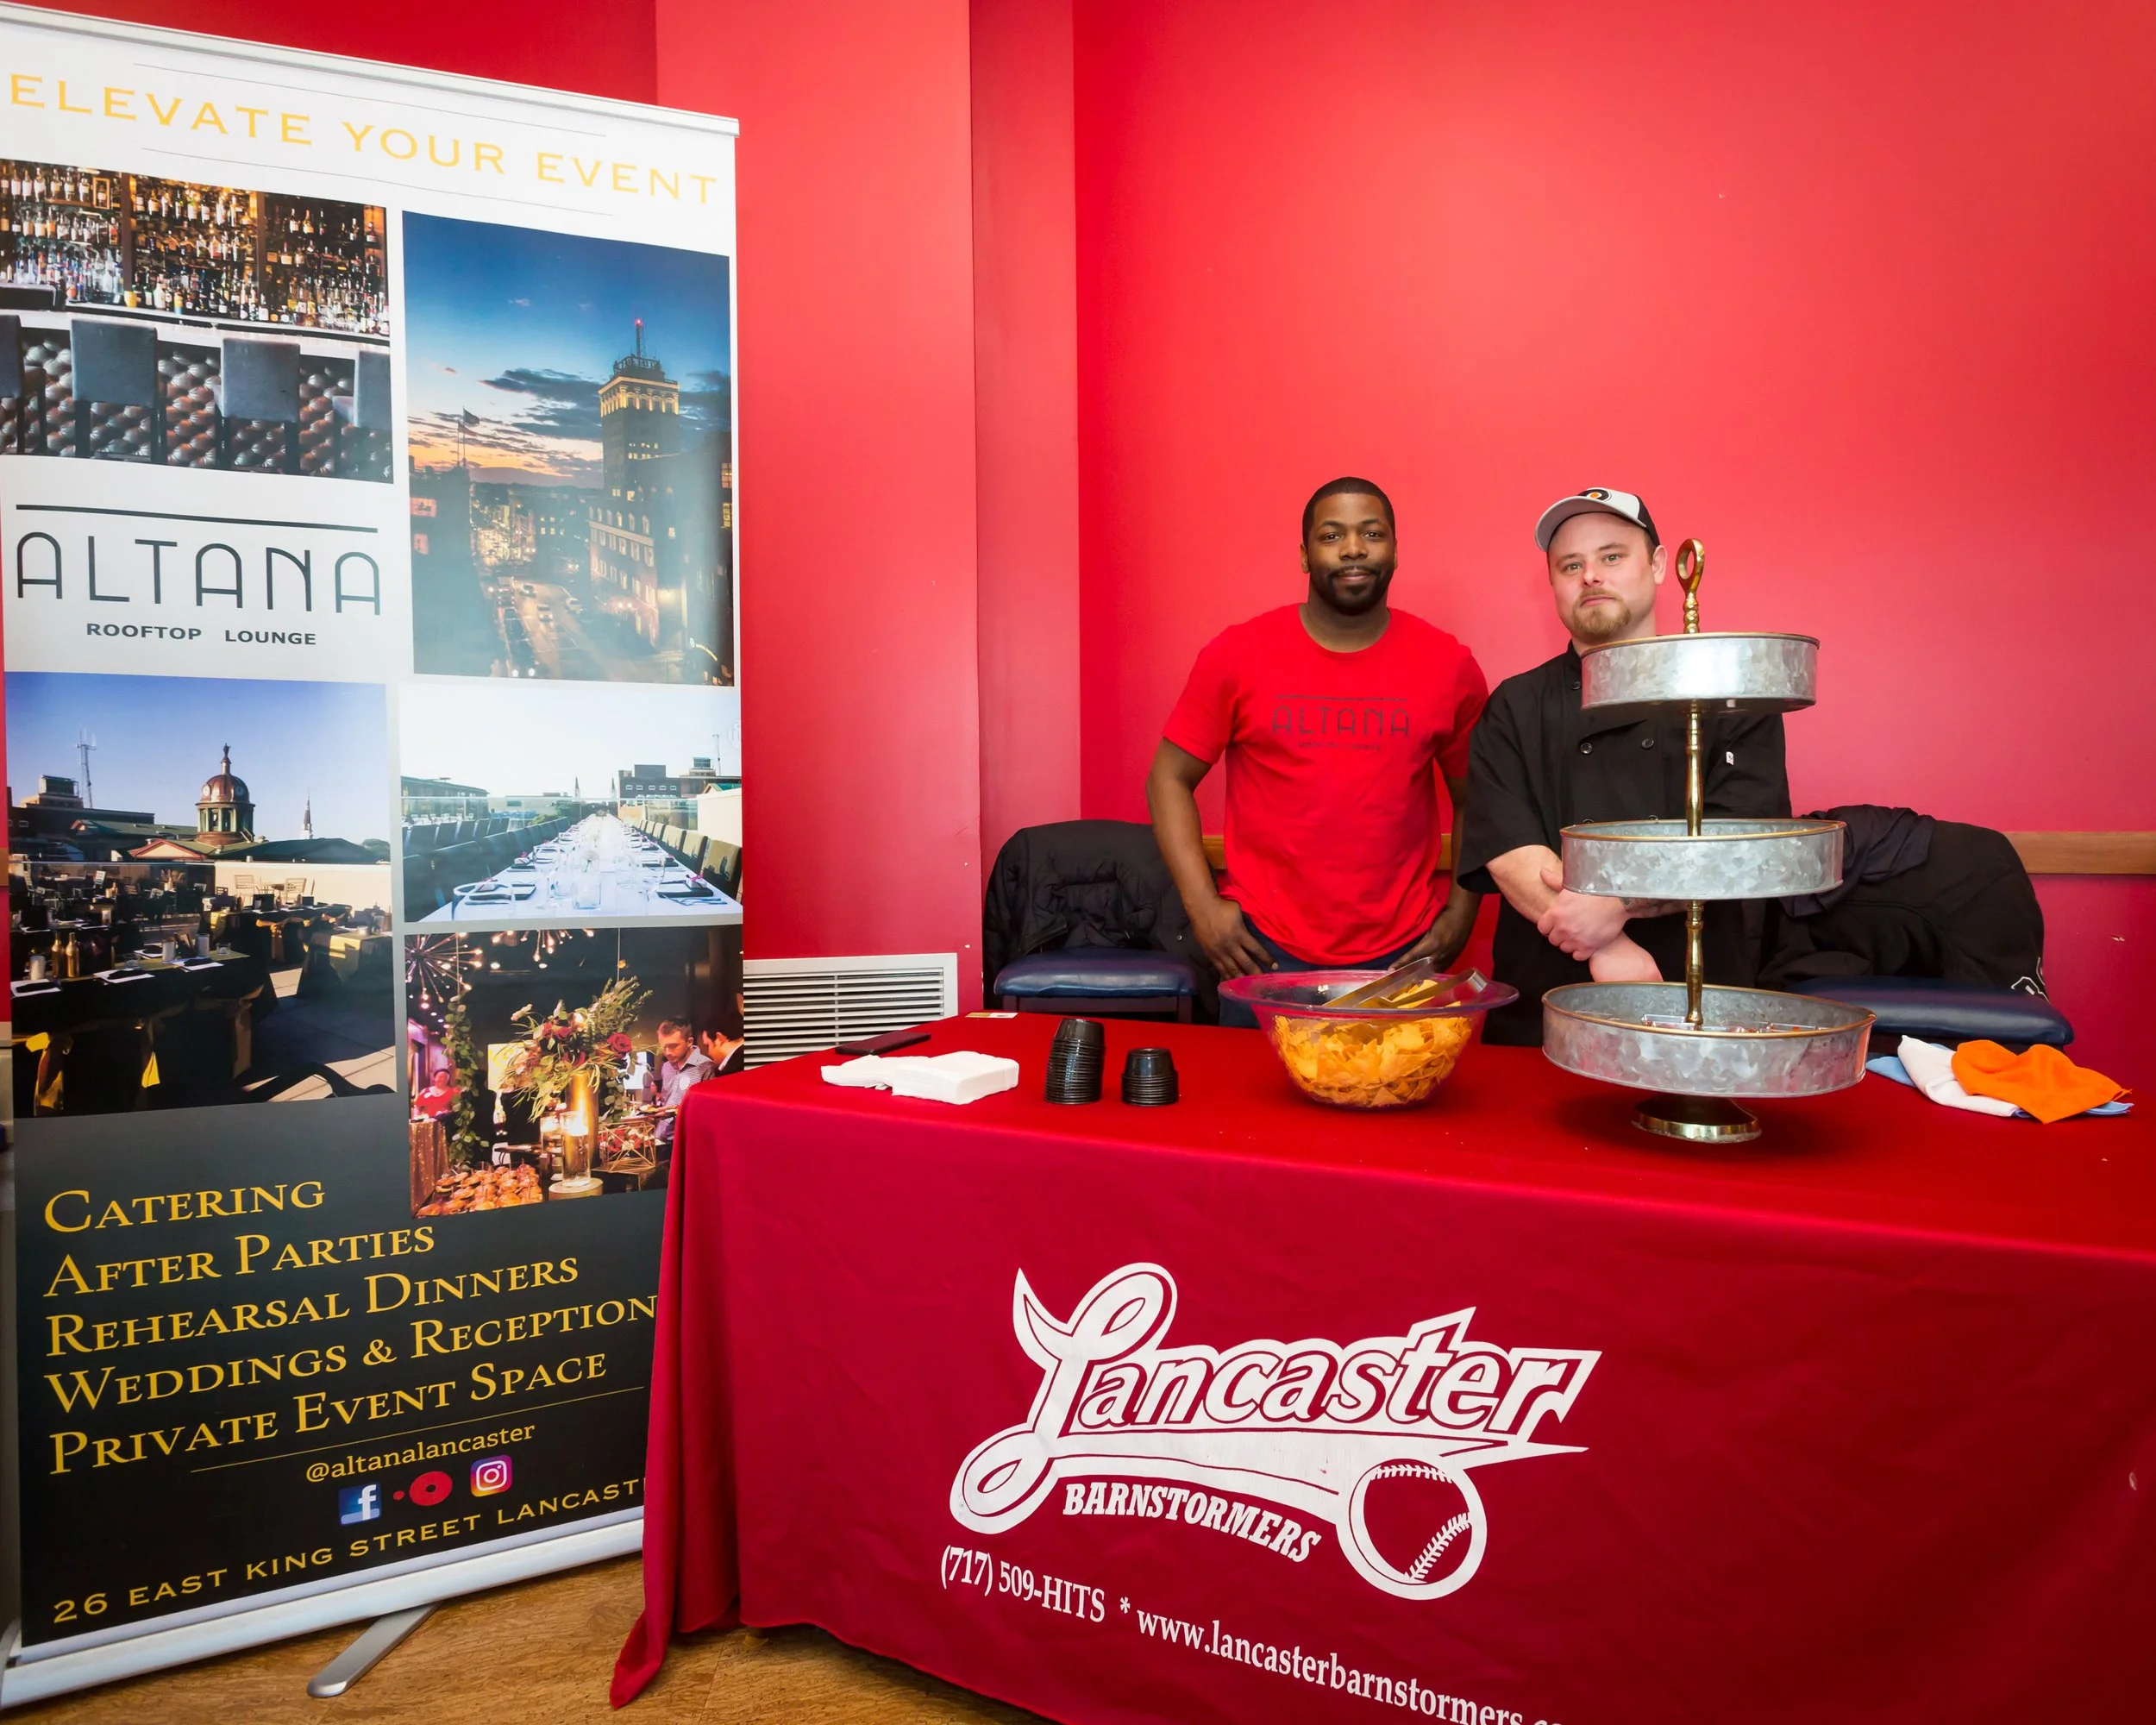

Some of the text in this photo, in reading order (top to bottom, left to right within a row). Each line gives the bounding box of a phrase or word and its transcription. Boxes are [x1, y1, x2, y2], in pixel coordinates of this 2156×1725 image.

[10, 72, 718, 205] ELEVATE YOUR EVENT
[16, 531, 380, 616] ALTANA
[86, 623, 317, 645] ROOFTOP LOUNGE
[1272, 706, 1409, 737] ALTANA
[44, 1180, 325, 1233] CATERING
[43, 1226, 436, 1297] AFTER PARTIES
[46, 1257, 579, 1357] REHEARSAL DINNERS
[45, 1295, 658, 1414] WEDDINGS & RECEPTION
[50, 1352, 607, 1475] PRIVATE EVENT SPACE
[950, 1262, 1602, 1534] Lancaster
[305, 1425, 536, 1484] @altanalancaster
[53, 1477, 646, 1624] 26 EAST KING STREET LANCAST
[1063, 1482, 1322, 1563] BARNSTORMERS
[941, 1545, 993, 1596] (717)
[999, 1560, 1105, 1622] 509-HITS
